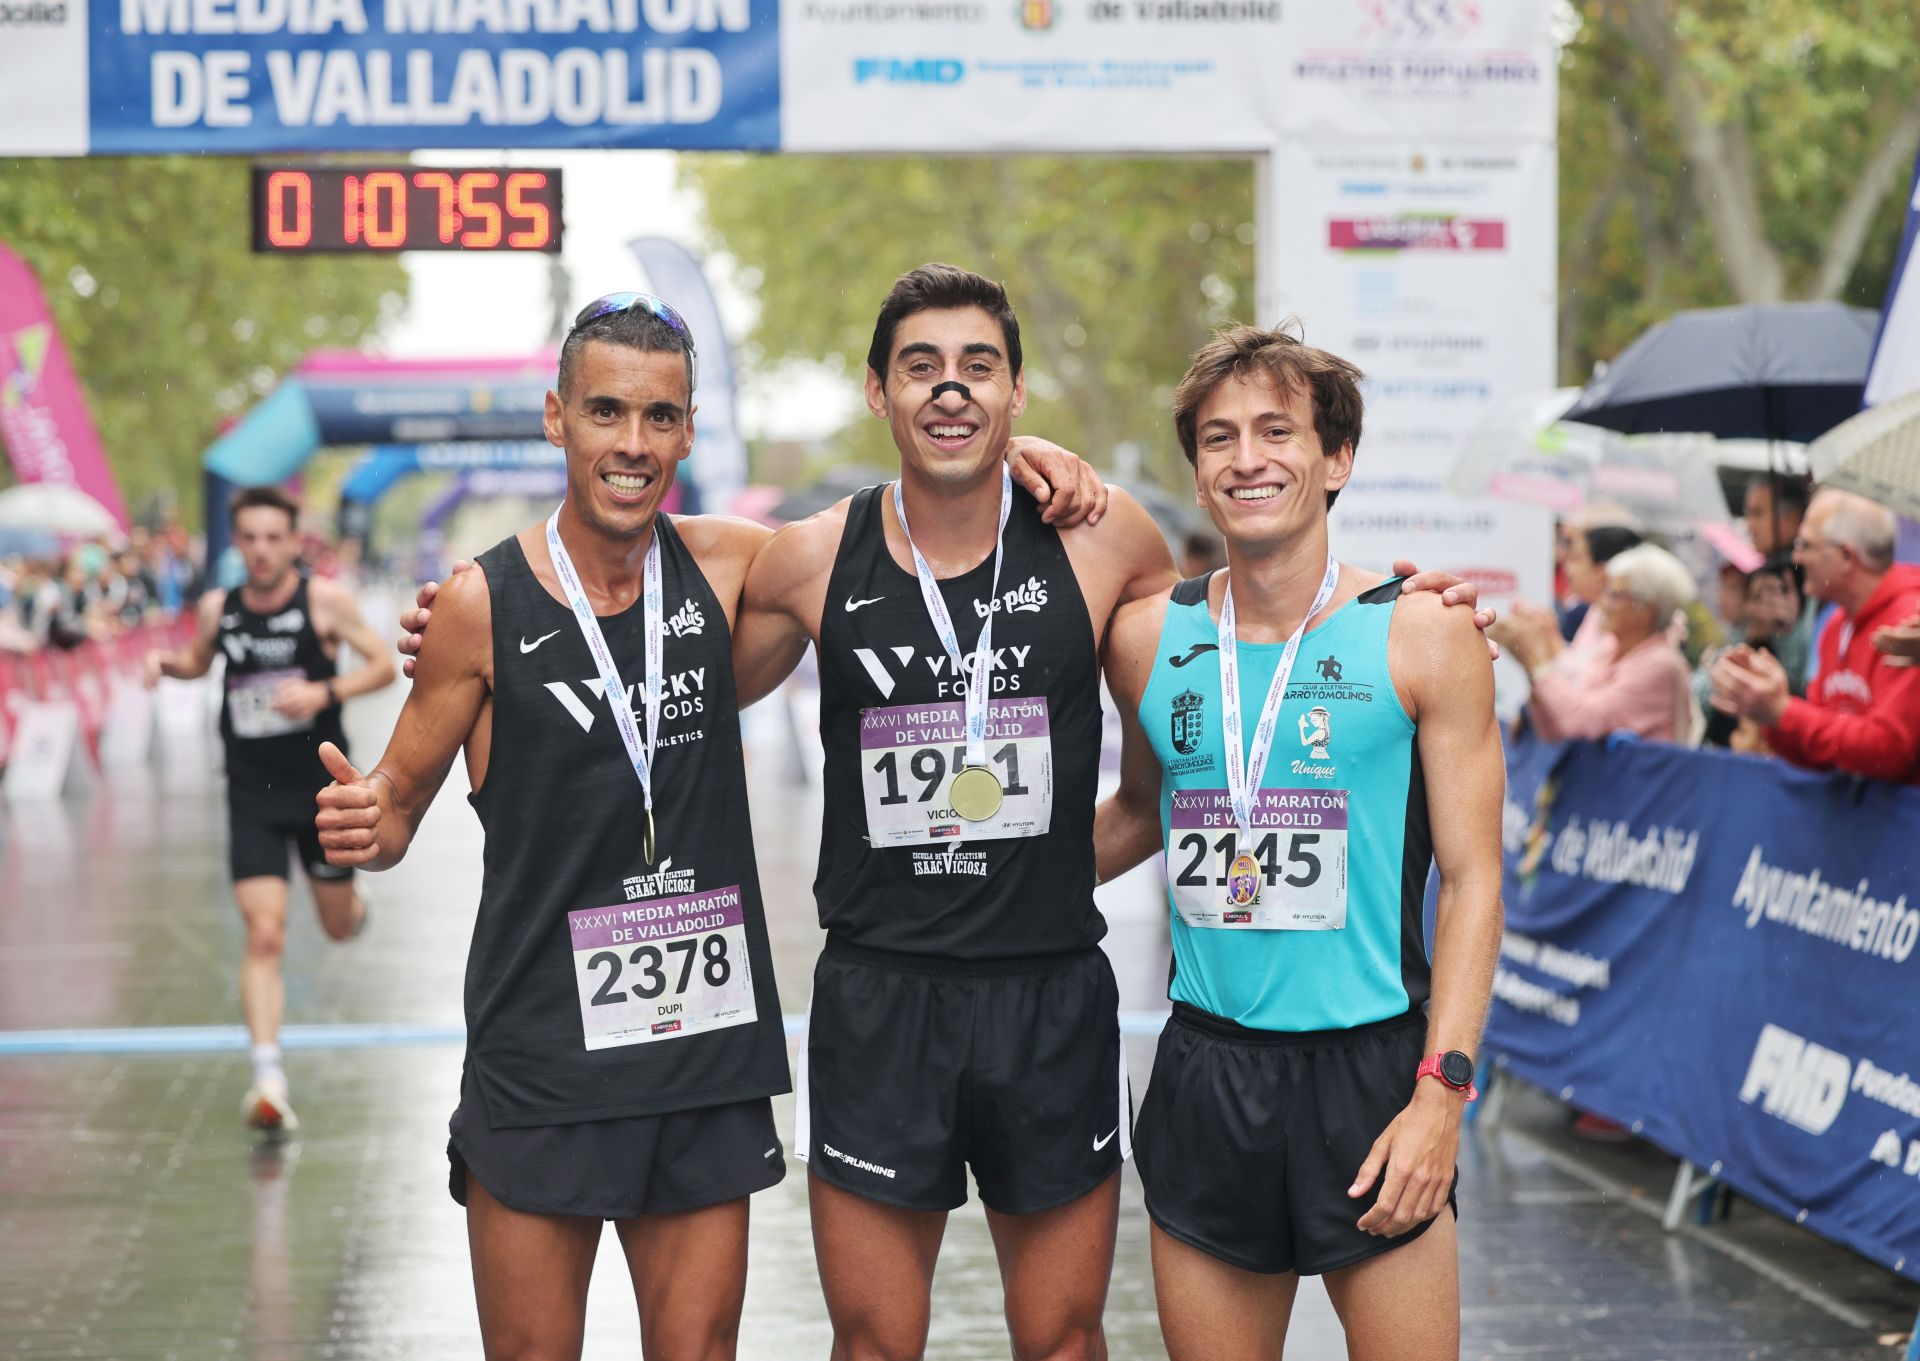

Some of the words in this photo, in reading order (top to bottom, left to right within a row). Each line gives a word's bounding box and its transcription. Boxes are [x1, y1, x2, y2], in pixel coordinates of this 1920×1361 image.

[151, 51, 252, 126] DE
[267, 48, 722, 126] VALLADOLID
[973, 599, 1001, 618] be
[1002, 580, 1048, 614] plus
[662, 622, 672, 637] e
[668, 600, 706, 638] plus
[925, 645, 1031, 678] VICKY
[938, 674, 1021, 698] FODS
[1282, 690, 1373, 703] ARROYOMOLINOS
[632, 697, 704, 723] ODS
[863, 714, 901, 730] XXXVI
[906, 709, 960, 726] MEDIA
[985, 701, 1044, 720] RATÓN
[641, 730, 704, 750] AHLETICS
[895, 730, 917, 744] DE
[920, 723, 1023, 742] VALLAOLID
[1291, 759, 1336, 779] Unique
[1174, 796, 1210, 809] XXXVI
[1214, 795, 1263, 808] MEA
[1266, 792, 1345, 809] MARATÓN
[927, 808, 963, 820] VICIO
[1203, 813, 1221, 826] DE
[1225, 813, 1322, 826] VLADOLID
[912, 852, 933, 860] ESCUELA
[954, 851, 987, 860] ATLETISMO
[913, 860, 943, 876] ISAAC
[941, 852, 988, 877] VICIOSA
[1176, 832, 1322, 888] 2145
[622, 875, 646, 886] ESCUELA
[665, 868, 695, 880] ATLETISMO
[624, 881, 656, 901] ISAAC
[653, 872, 696, 895] VICIOSA
[573, 912, 618, 931] XXXVI
[621, 906, 675, 925] MEDIA
[677, 891, 739, 916] MARATÓN
[1732, 844, 1920, 963] Ayuntamiento
[611, 928, 634, 943] DE
[637, 913, 725, 940] VALLADOLID
[586, 933, 731, 1007] 2378
[657, 1003, 684, 1016] DUPI
[1738, 1021, 1852, 1136] FMD
